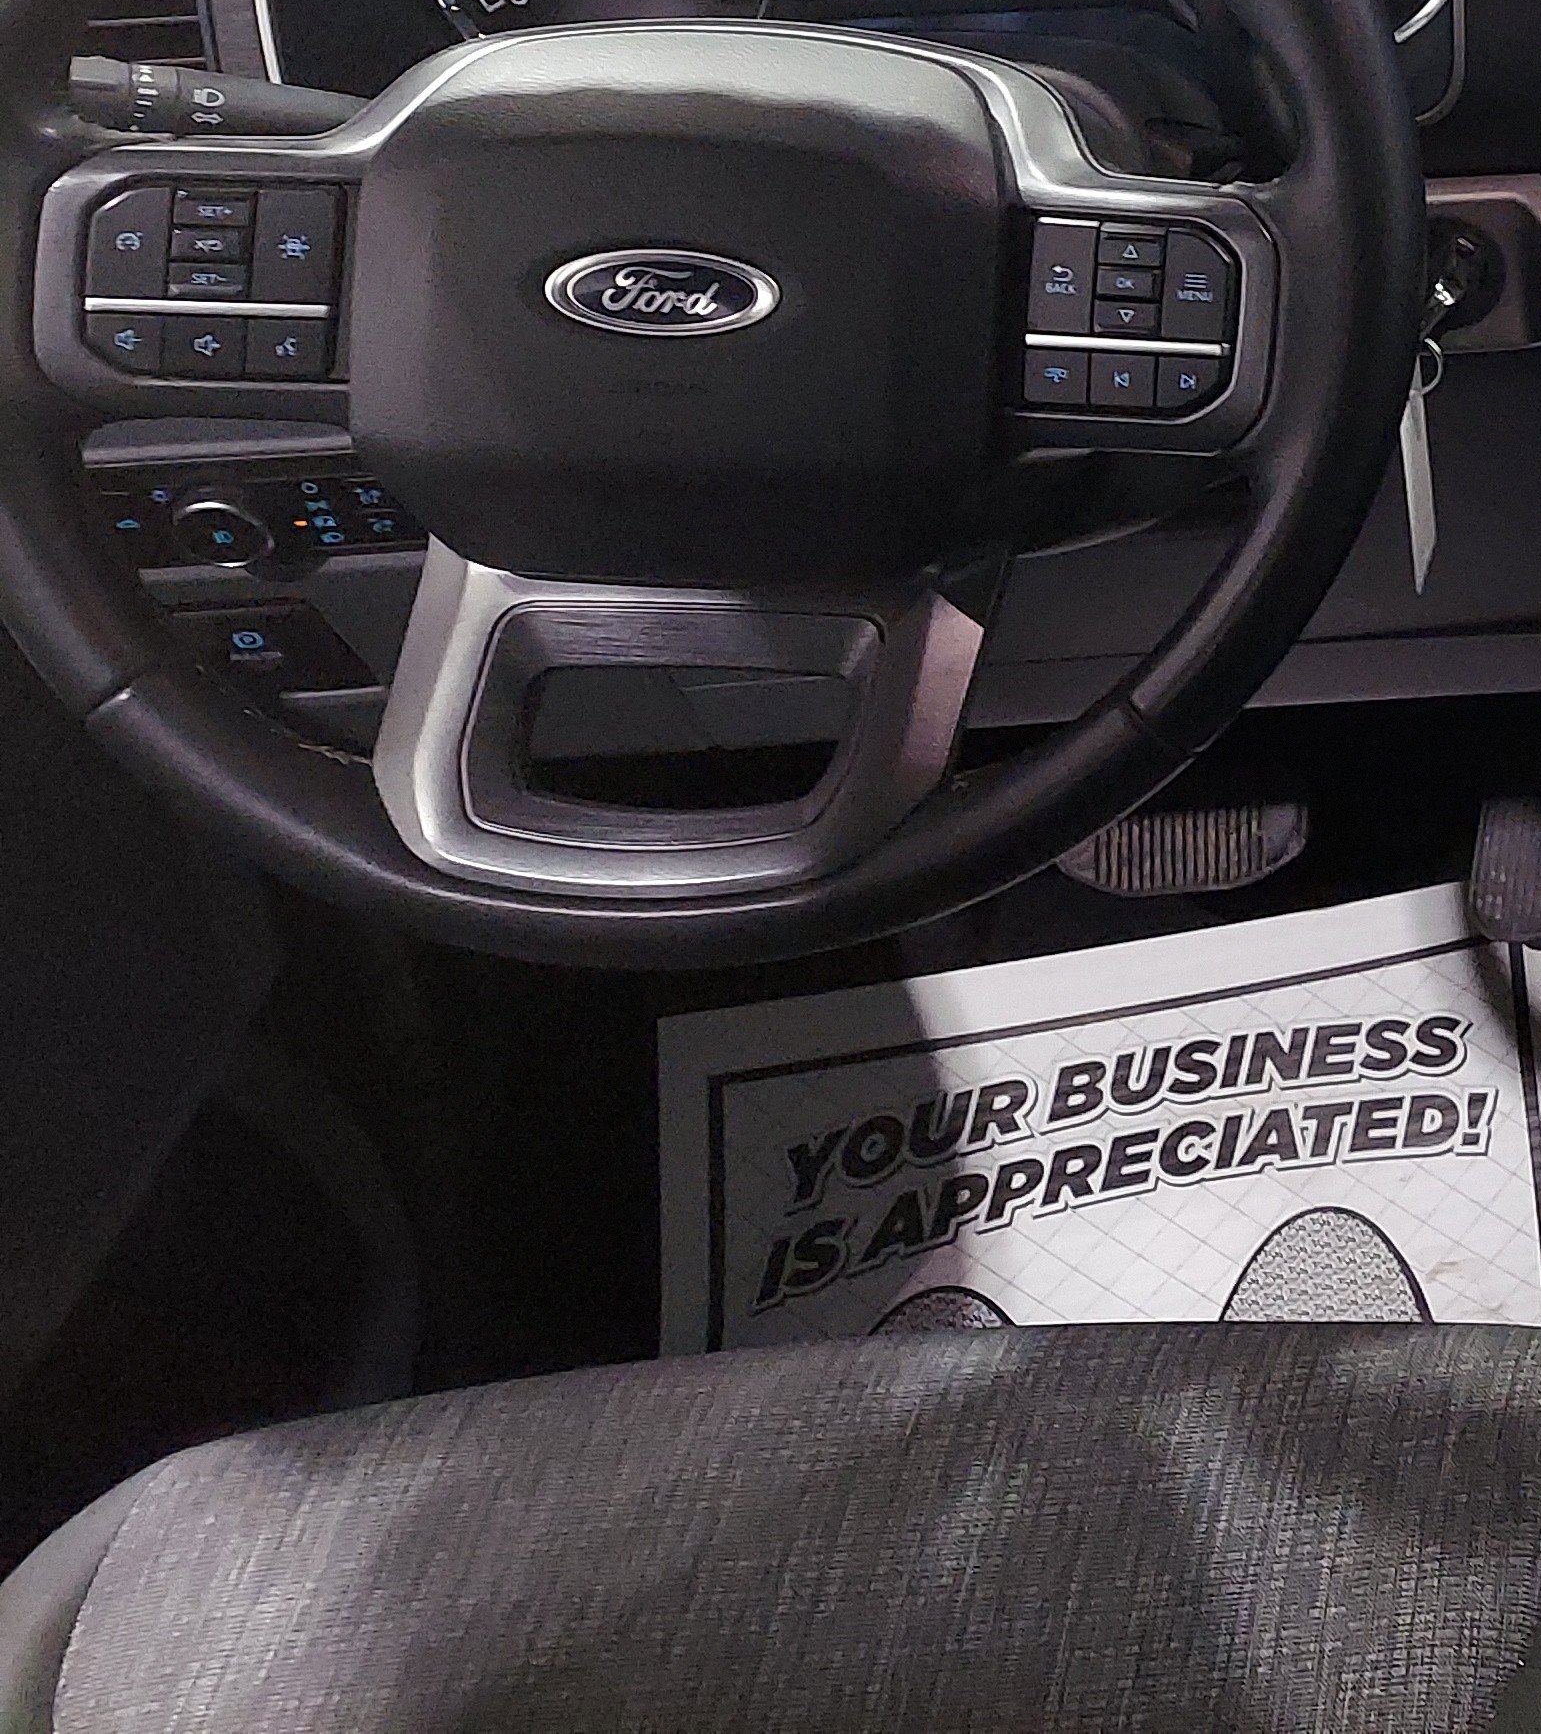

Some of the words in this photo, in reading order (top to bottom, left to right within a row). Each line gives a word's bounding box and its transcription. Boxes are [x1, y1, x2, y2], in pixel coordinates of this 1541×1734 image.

[601, 266, 720, 316] Ford
[1045, 282, 1076, 295] BACK
[788, 1078, 1033, 1204] YOUR
[1046, 1017, 1470, 1124] BUSINESS
[757, 1219, 848, 1306] IS
[861, 1091, 1492, 1264] APPRECIATED!
